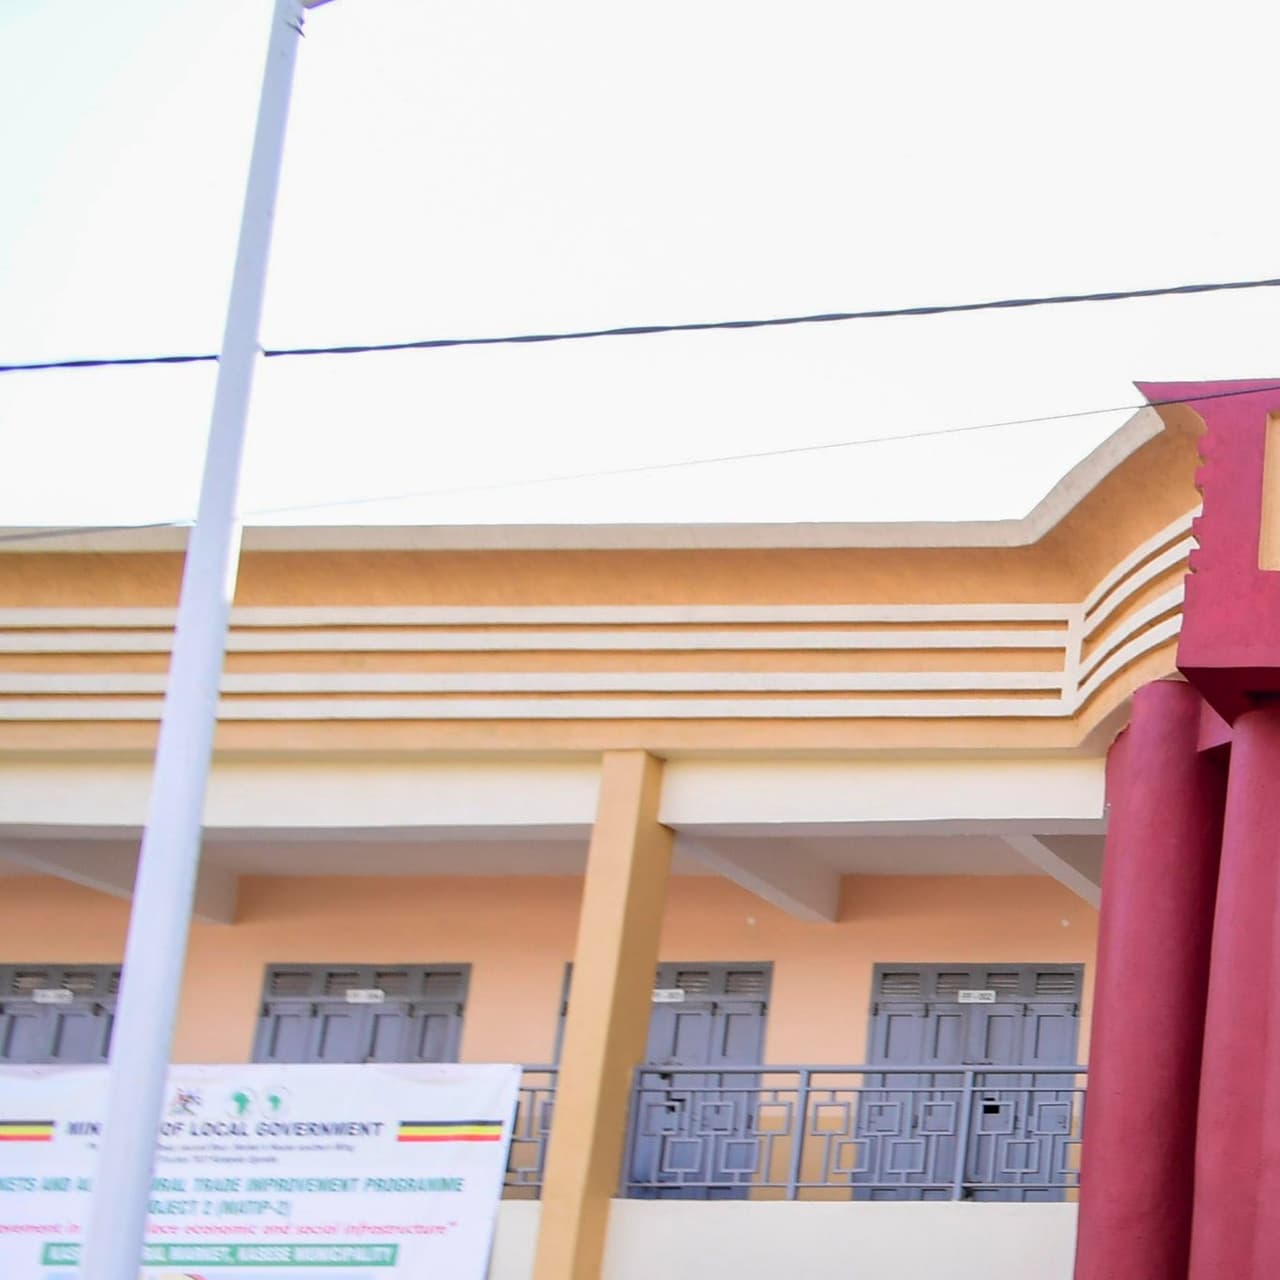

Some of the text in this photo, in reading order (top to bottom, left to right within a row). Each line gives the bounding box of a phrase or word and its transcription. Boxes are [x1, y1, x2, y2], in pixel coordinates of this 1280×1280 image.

[189, 1121, 249, 1137] LOCAL
[254, 1121, 384, 1138] GOVERNMENT
[193, 1177, 241, 1192] TRADE
[245, 1177, 360, 1192] IMPROVEMENT
[363, 1177, 465, 1192] PROGRAMME
